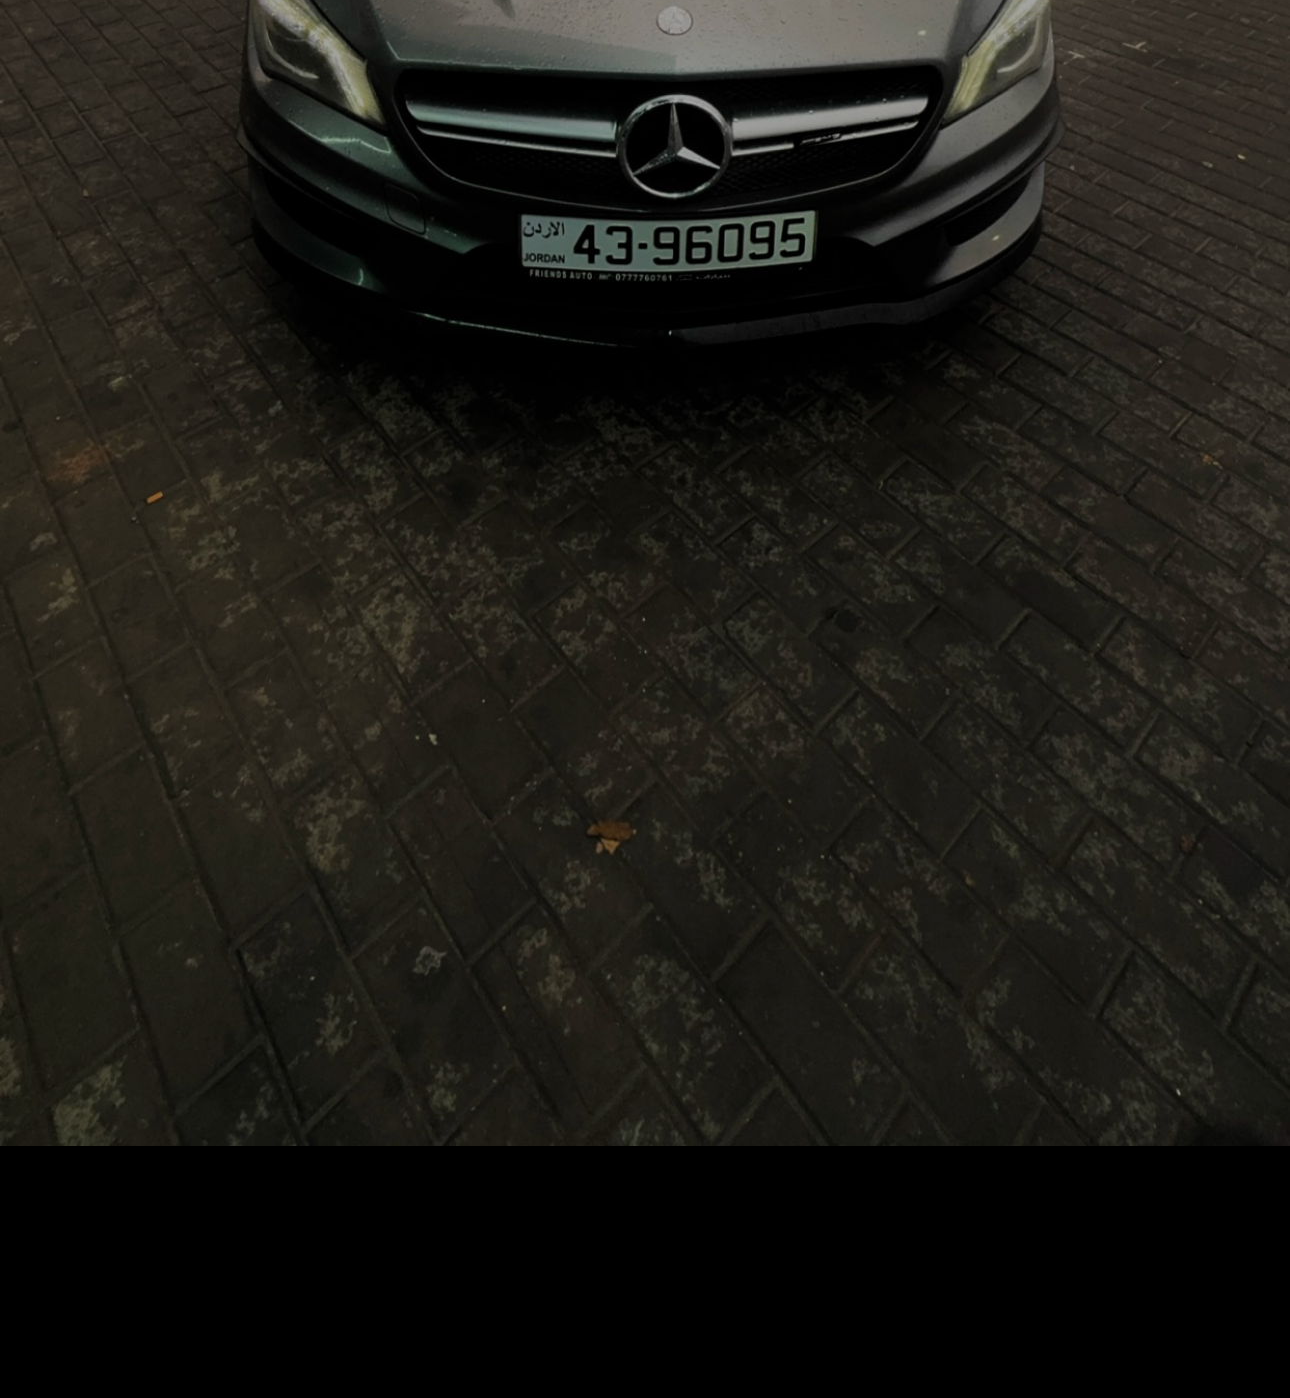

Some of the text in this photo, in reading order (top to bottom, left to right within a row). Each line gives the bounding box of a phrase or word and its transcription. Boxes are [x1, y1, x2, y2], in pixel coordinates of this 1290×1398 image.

[523, 221, 565, 239] الاردن
[573, 217, 806, 265] 43-96095
[523, 253, 565, 264] JORDAN
[529, 269, 567, 279] FRIENDS
[569, 271, 593, 280] AUTO
